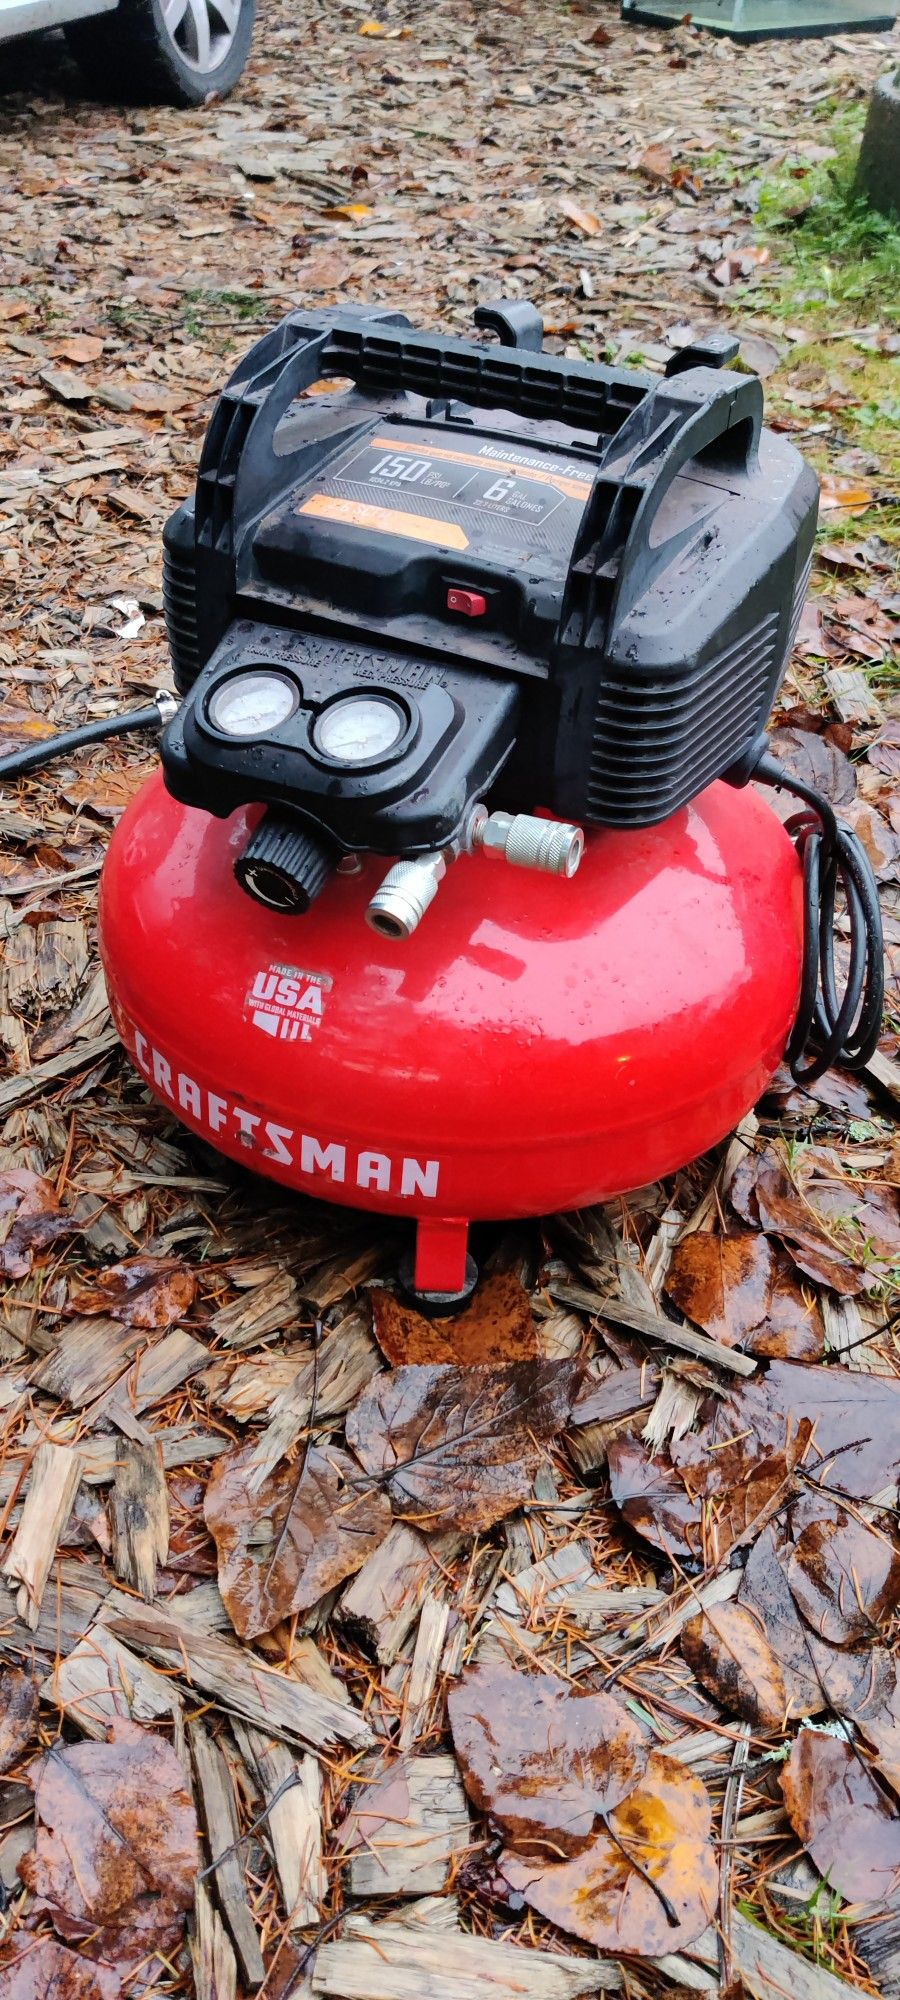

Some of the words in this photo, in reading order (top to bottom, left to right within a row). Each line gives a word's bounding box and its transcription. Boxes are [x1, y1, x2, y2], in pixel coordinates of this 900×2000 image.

[369, 454, 433, 482] 150
[426, 471, 443, 479] PSI
[478, 445, 596, 482] Maintenance-Free
[482, 478, 517, 501] 6
[504, 496, 545, 513] GALONES
[272, 648, 322, 669] PRESSURE
[377, 672, 430, 692] PRESSURE
[268, 964, 292, 978] MADE
[294, 970, 305, 980] IN
[306, 973, 323, 985] THE
[252, 971, 324, 1016] USA
[248, 998, 265, 1010] WITH
[264, 1001, 286, 1017] GLOBAL
[286, 1009, 321, 1028] MATERIALS
[134, 1030, 440, 1199] CRAFTSMAN
